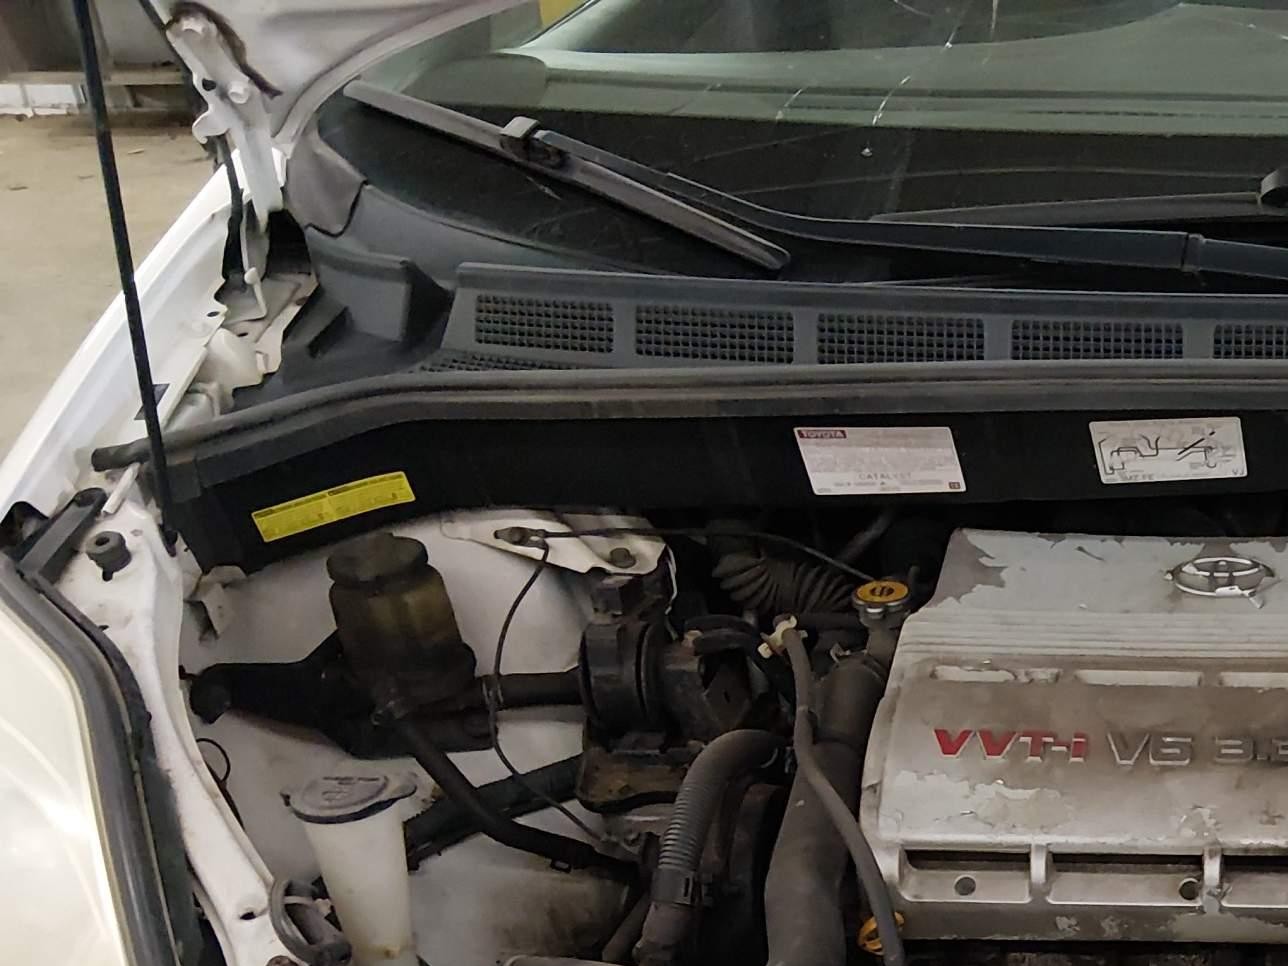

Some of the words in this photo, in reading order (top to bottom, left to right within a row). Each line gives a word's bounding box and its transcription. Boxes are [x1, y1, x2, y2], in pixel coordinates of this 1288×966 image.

[800, 430, 845, 438] TOYOTA
[858, 472, 912, 480] CATALYST
[1107, 731, 1193, 765] V6
